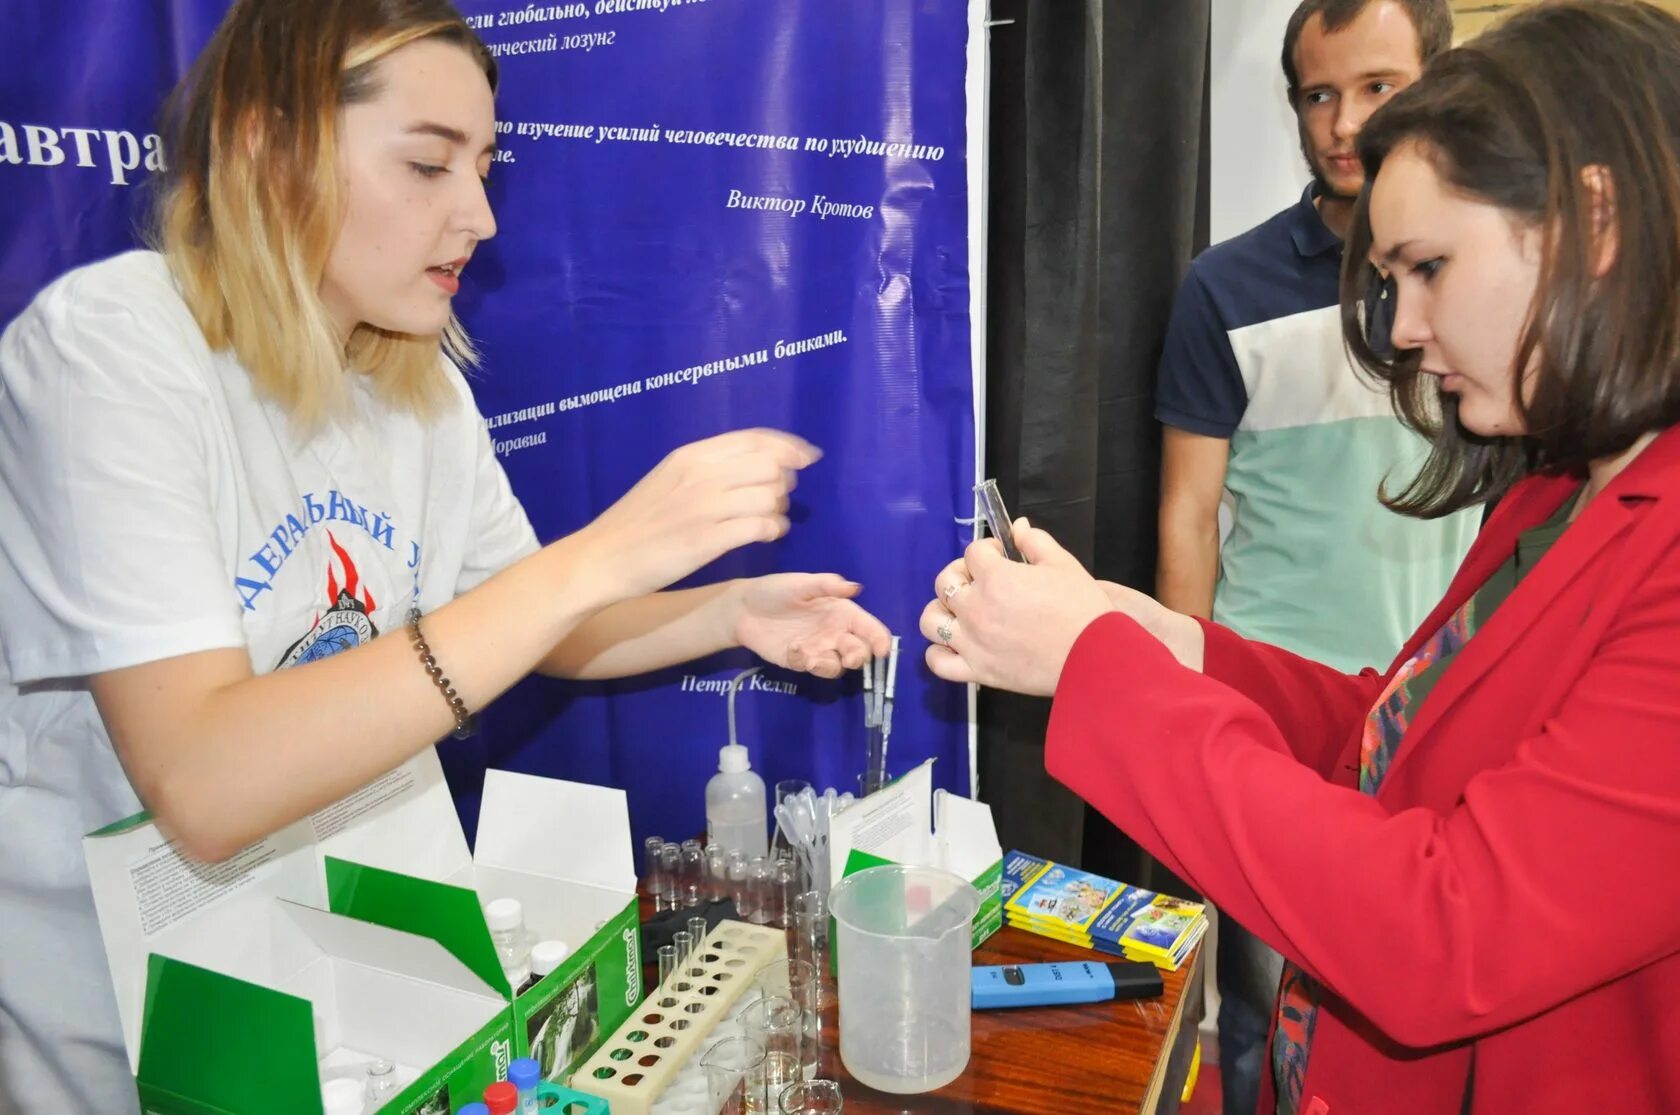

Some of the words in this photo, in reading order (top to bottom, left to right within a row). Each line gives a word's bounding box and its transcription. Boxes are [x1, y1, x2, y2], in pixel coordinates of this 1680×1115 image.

[463, 14, 494, 29] сли
[498, 3, 590, 27] глобально,
[560, 30, 616, 52] лозунг
[0, 121, 168, 185] автра
[517, 121, 594, 140] изучение
[595, 124, 660, 144] усилий
[665, 128, 799, 150] человечества
[804, 136, 828, 152] по
[828, 134, 945, 161] ухудшению
[726, 189, 806, 217] Виктор
[810, 195, 874, 219] Кротов
[559, 380, 642, 412] вымощена
[645, 348, 769, 391] консервными
[774, 328, 848, 360] банками.
[749, 673, 798, 695] Келли
